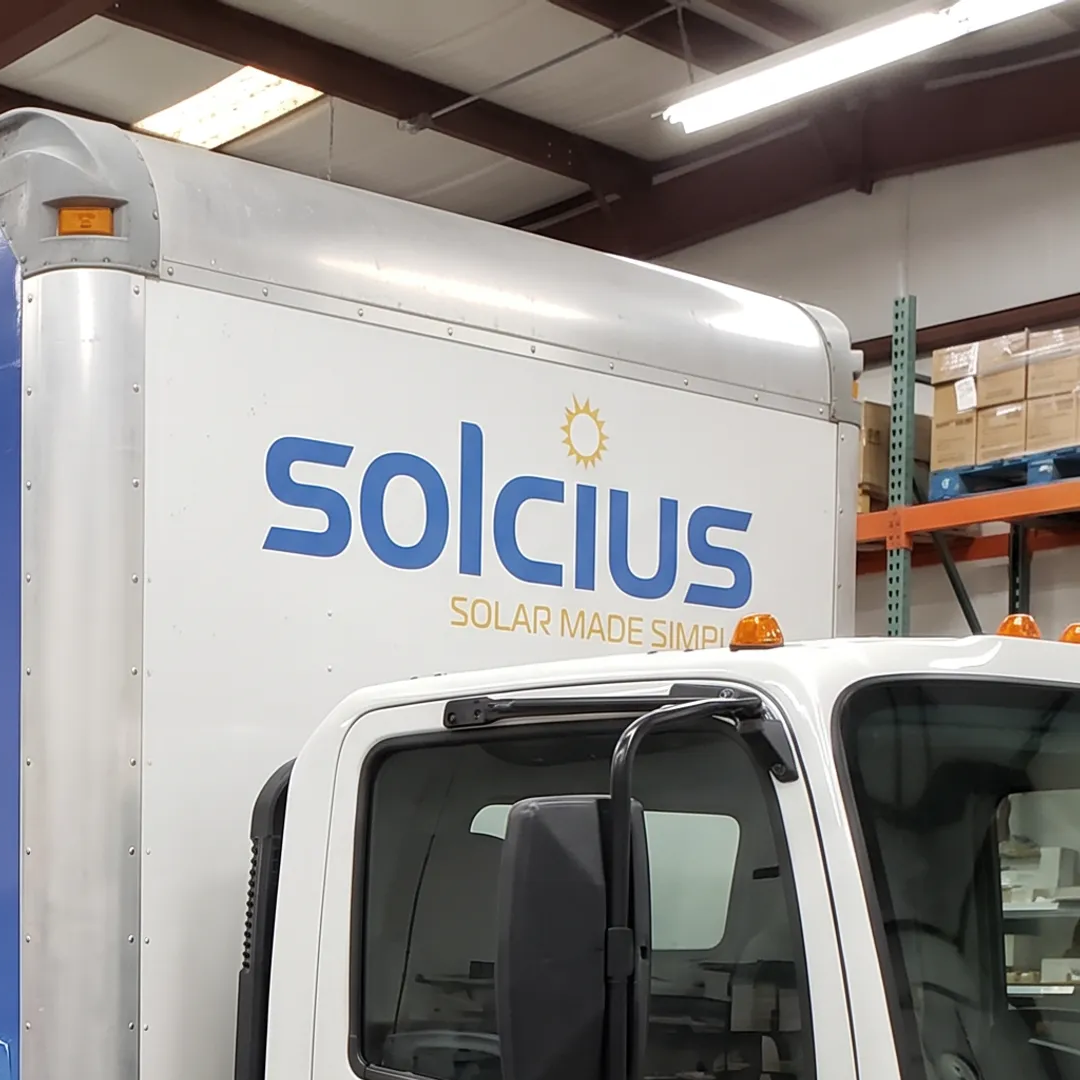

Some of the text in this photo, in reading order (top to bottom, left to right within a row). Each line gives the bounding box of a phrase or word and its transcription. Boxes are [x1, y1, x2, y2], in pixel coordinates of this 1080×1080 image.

[262, 420, 753, 610] solcius
[450, 596, 724, 650] SOLAR MADE SIMP
